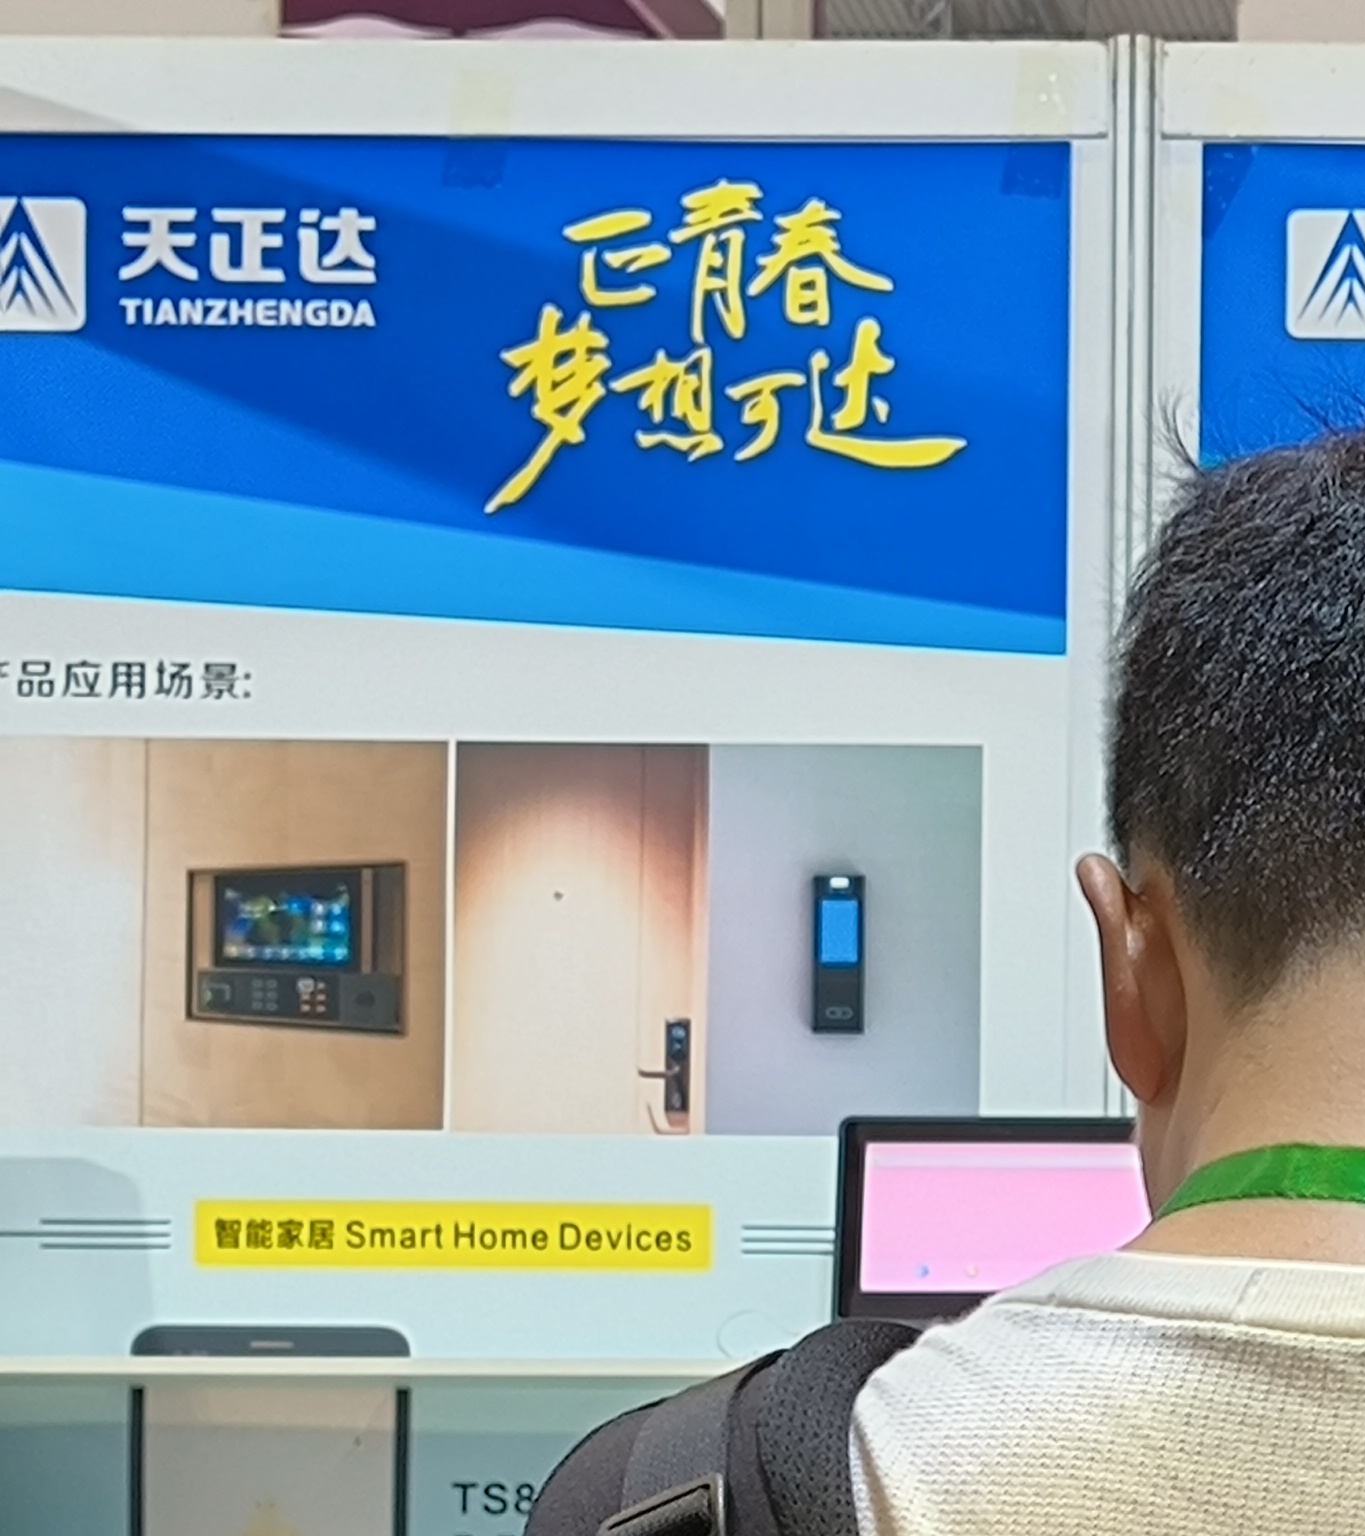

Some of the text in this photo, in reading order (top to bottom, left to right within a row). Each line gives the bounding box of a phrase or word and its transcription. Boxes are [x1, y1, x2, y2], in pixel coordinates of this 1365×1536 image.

[118, 206, 378, 285] 天正达
[120, 298, 377, 328] TIANZHENGDA
[484, 305, 967, 513] 梦想可达
[214, 1217, 694, 1253] 智能家居 Smart Home Devices
